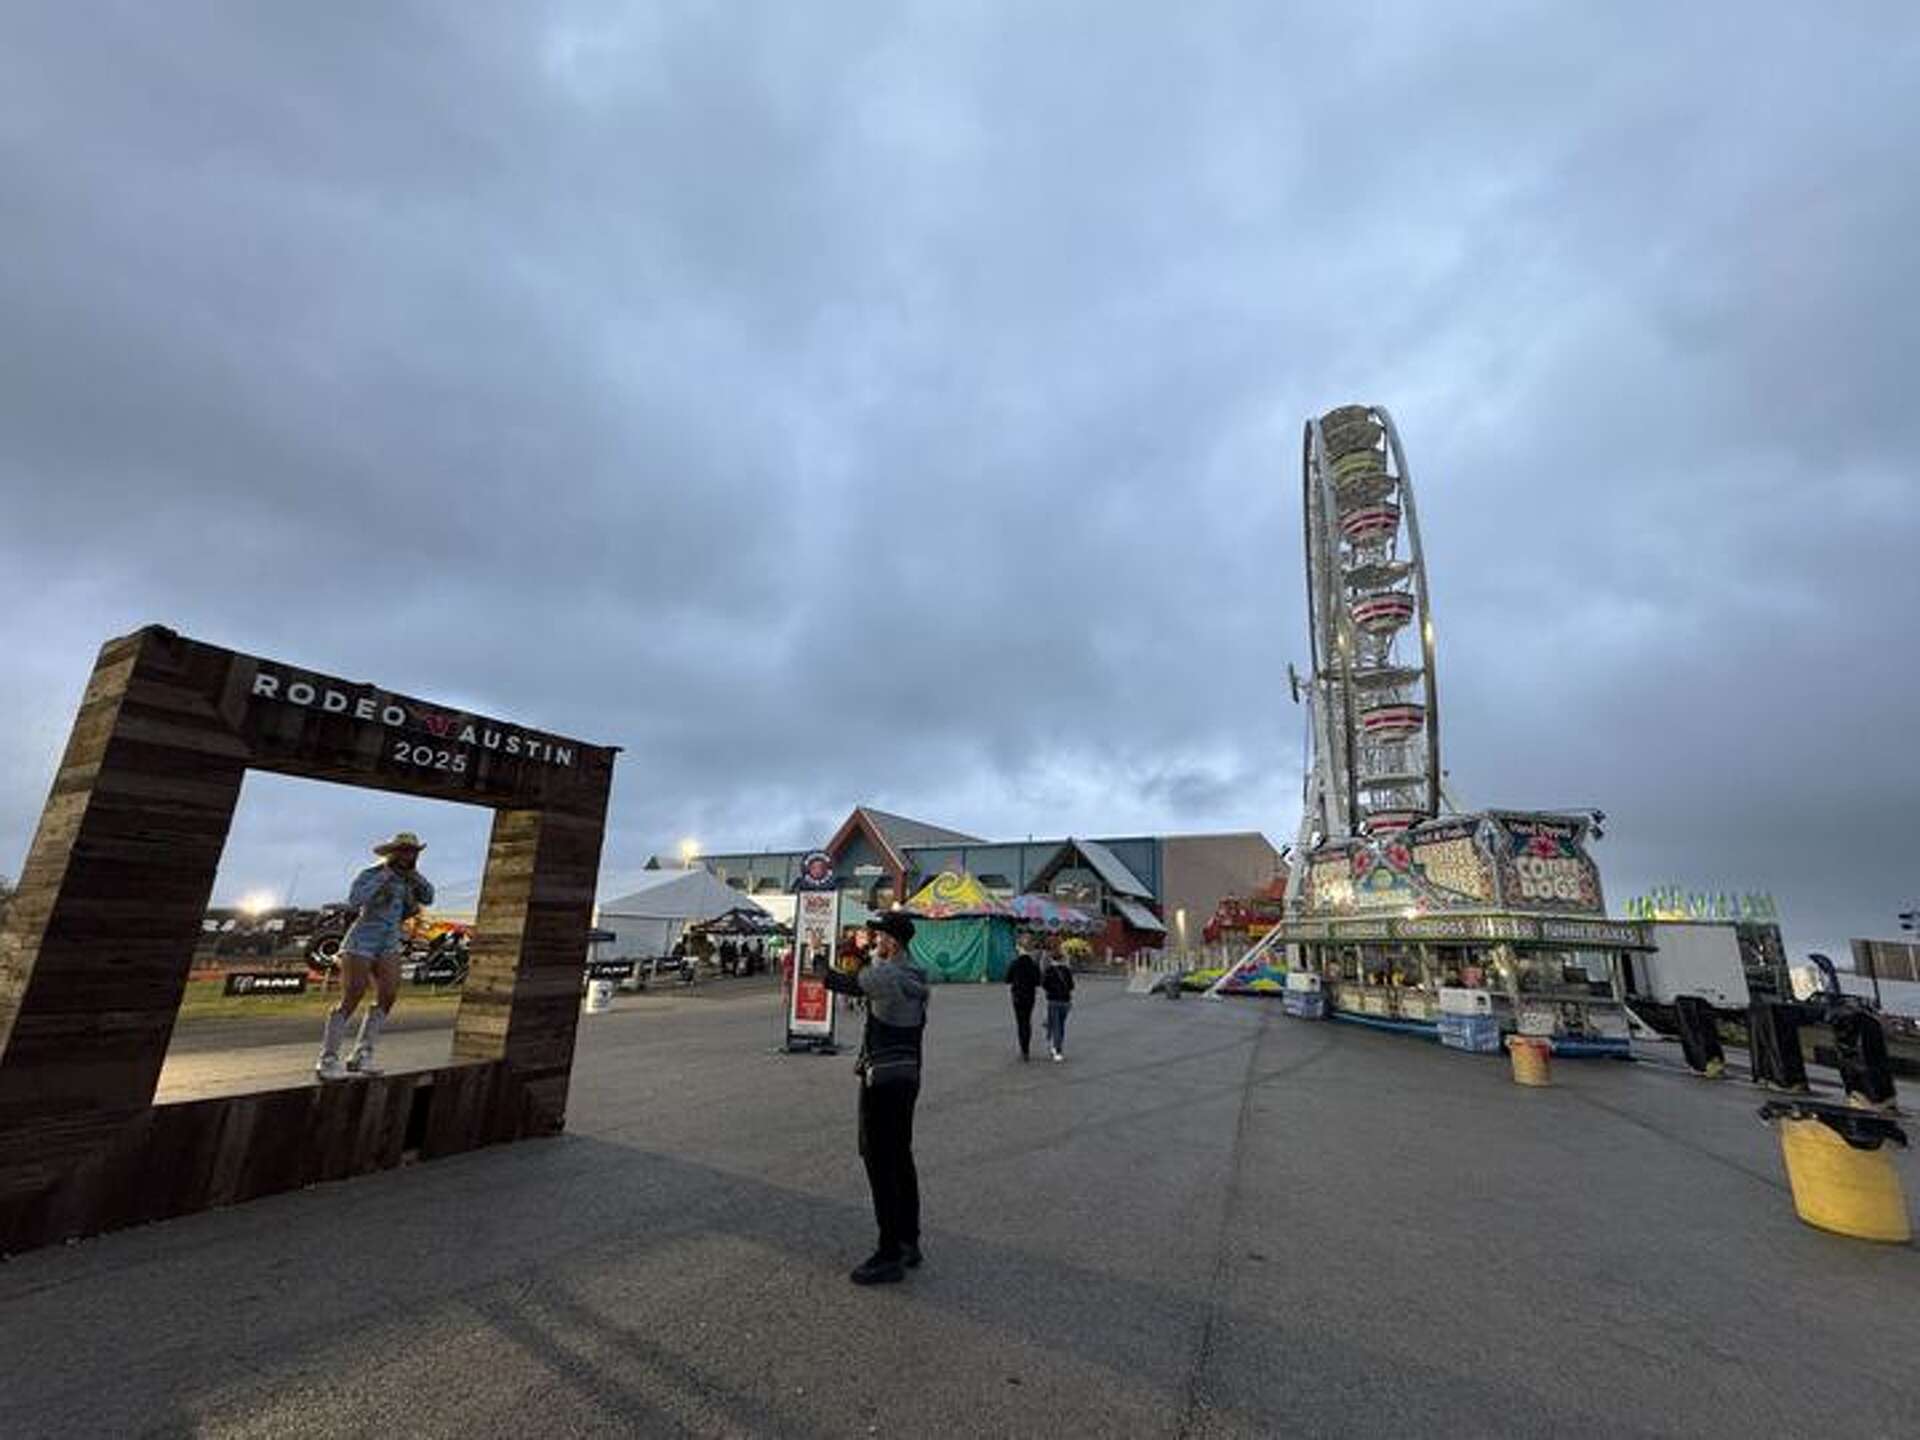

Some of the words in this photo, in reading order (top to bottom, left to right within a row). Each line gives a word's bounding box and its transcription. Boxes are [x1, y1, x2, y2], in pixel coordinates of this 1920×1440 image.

[252, 673, 407, 727] RODEO
[458, 726, 574, 766] AUSTIN
[393, 741, 468, 774] 2025
[1521, 878, 1579, 899] DOGS
